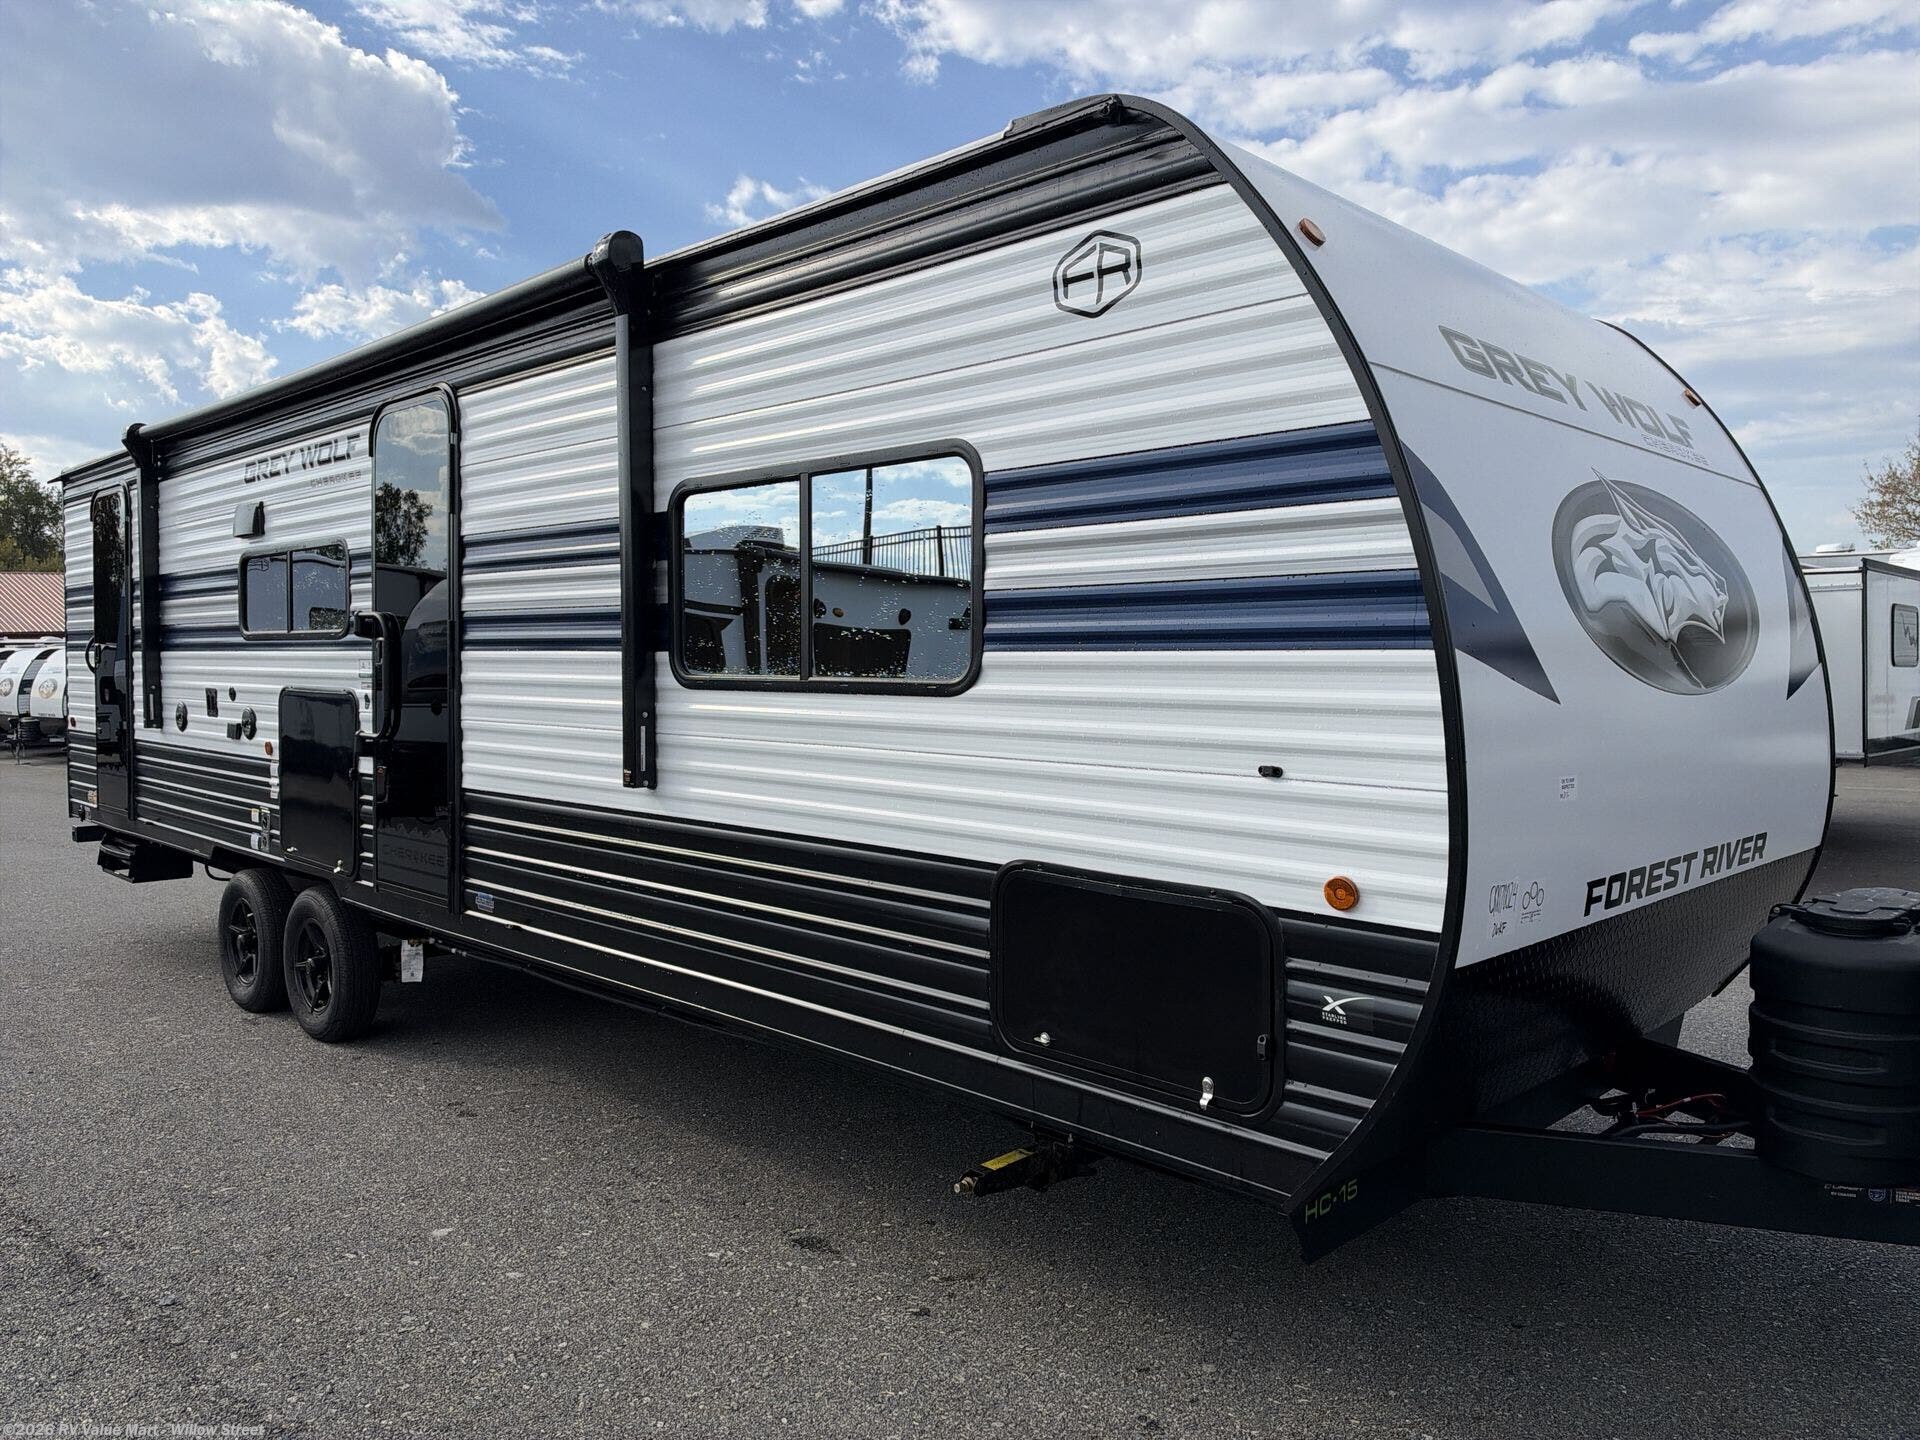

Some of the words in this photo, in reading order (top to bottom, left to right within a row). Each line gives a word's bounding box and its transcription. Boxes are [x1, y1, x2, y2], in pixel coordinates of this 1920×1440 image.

[1438, 325, 1588, 412] GREY
[1584, 379, 1693, 450] WOLF
[244, 449, 296, 484] GREY
[300, 433, 360, 470] WOLF
[1583, 851, 1699, 918] FOREST
[1699, 831, 1768, 879] RIVER
